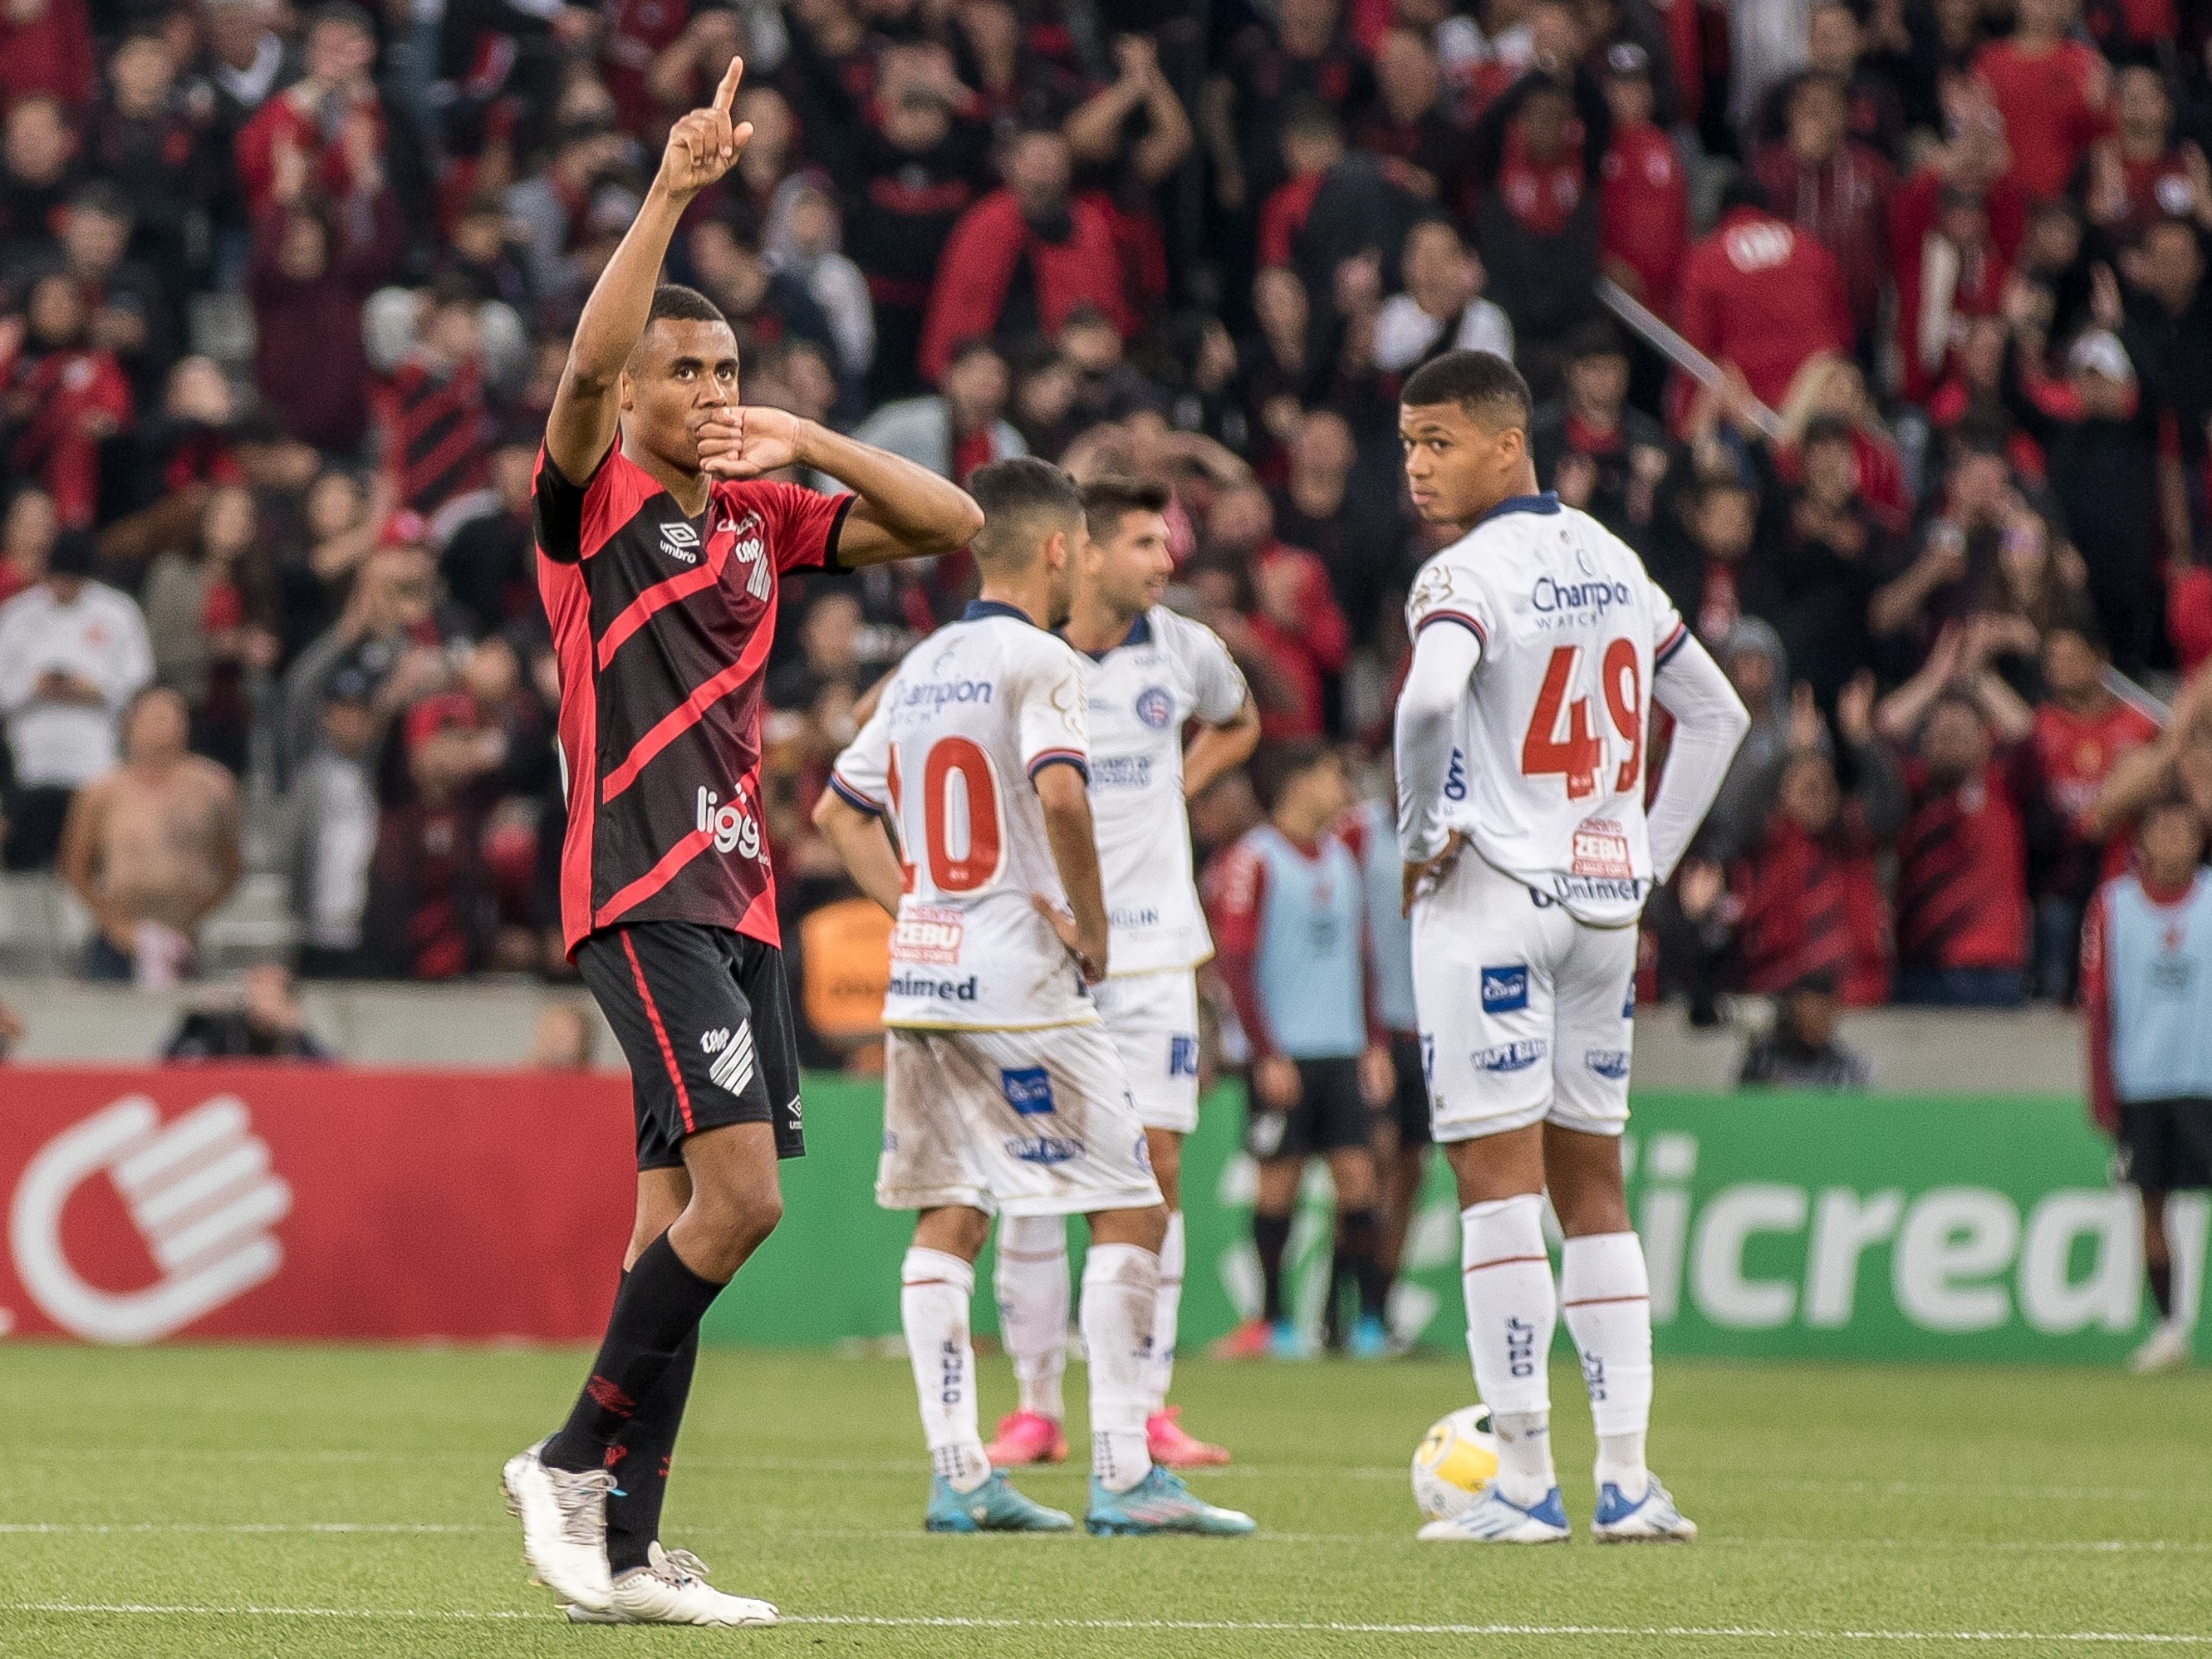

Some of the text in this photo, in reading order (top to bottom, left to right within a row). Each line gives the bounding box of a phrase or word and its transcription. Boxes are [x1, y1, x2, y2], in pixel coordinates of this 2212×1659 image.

[660, 540, 697, 564] umbro
[1521, 636, 1643, 803] 49
[697, 783, 760, 859] ligg
[885, 734, 1008, 897] 0
[897, 922, 961, 950] ZEBU
[889, 969, 978, 1001] nimed
